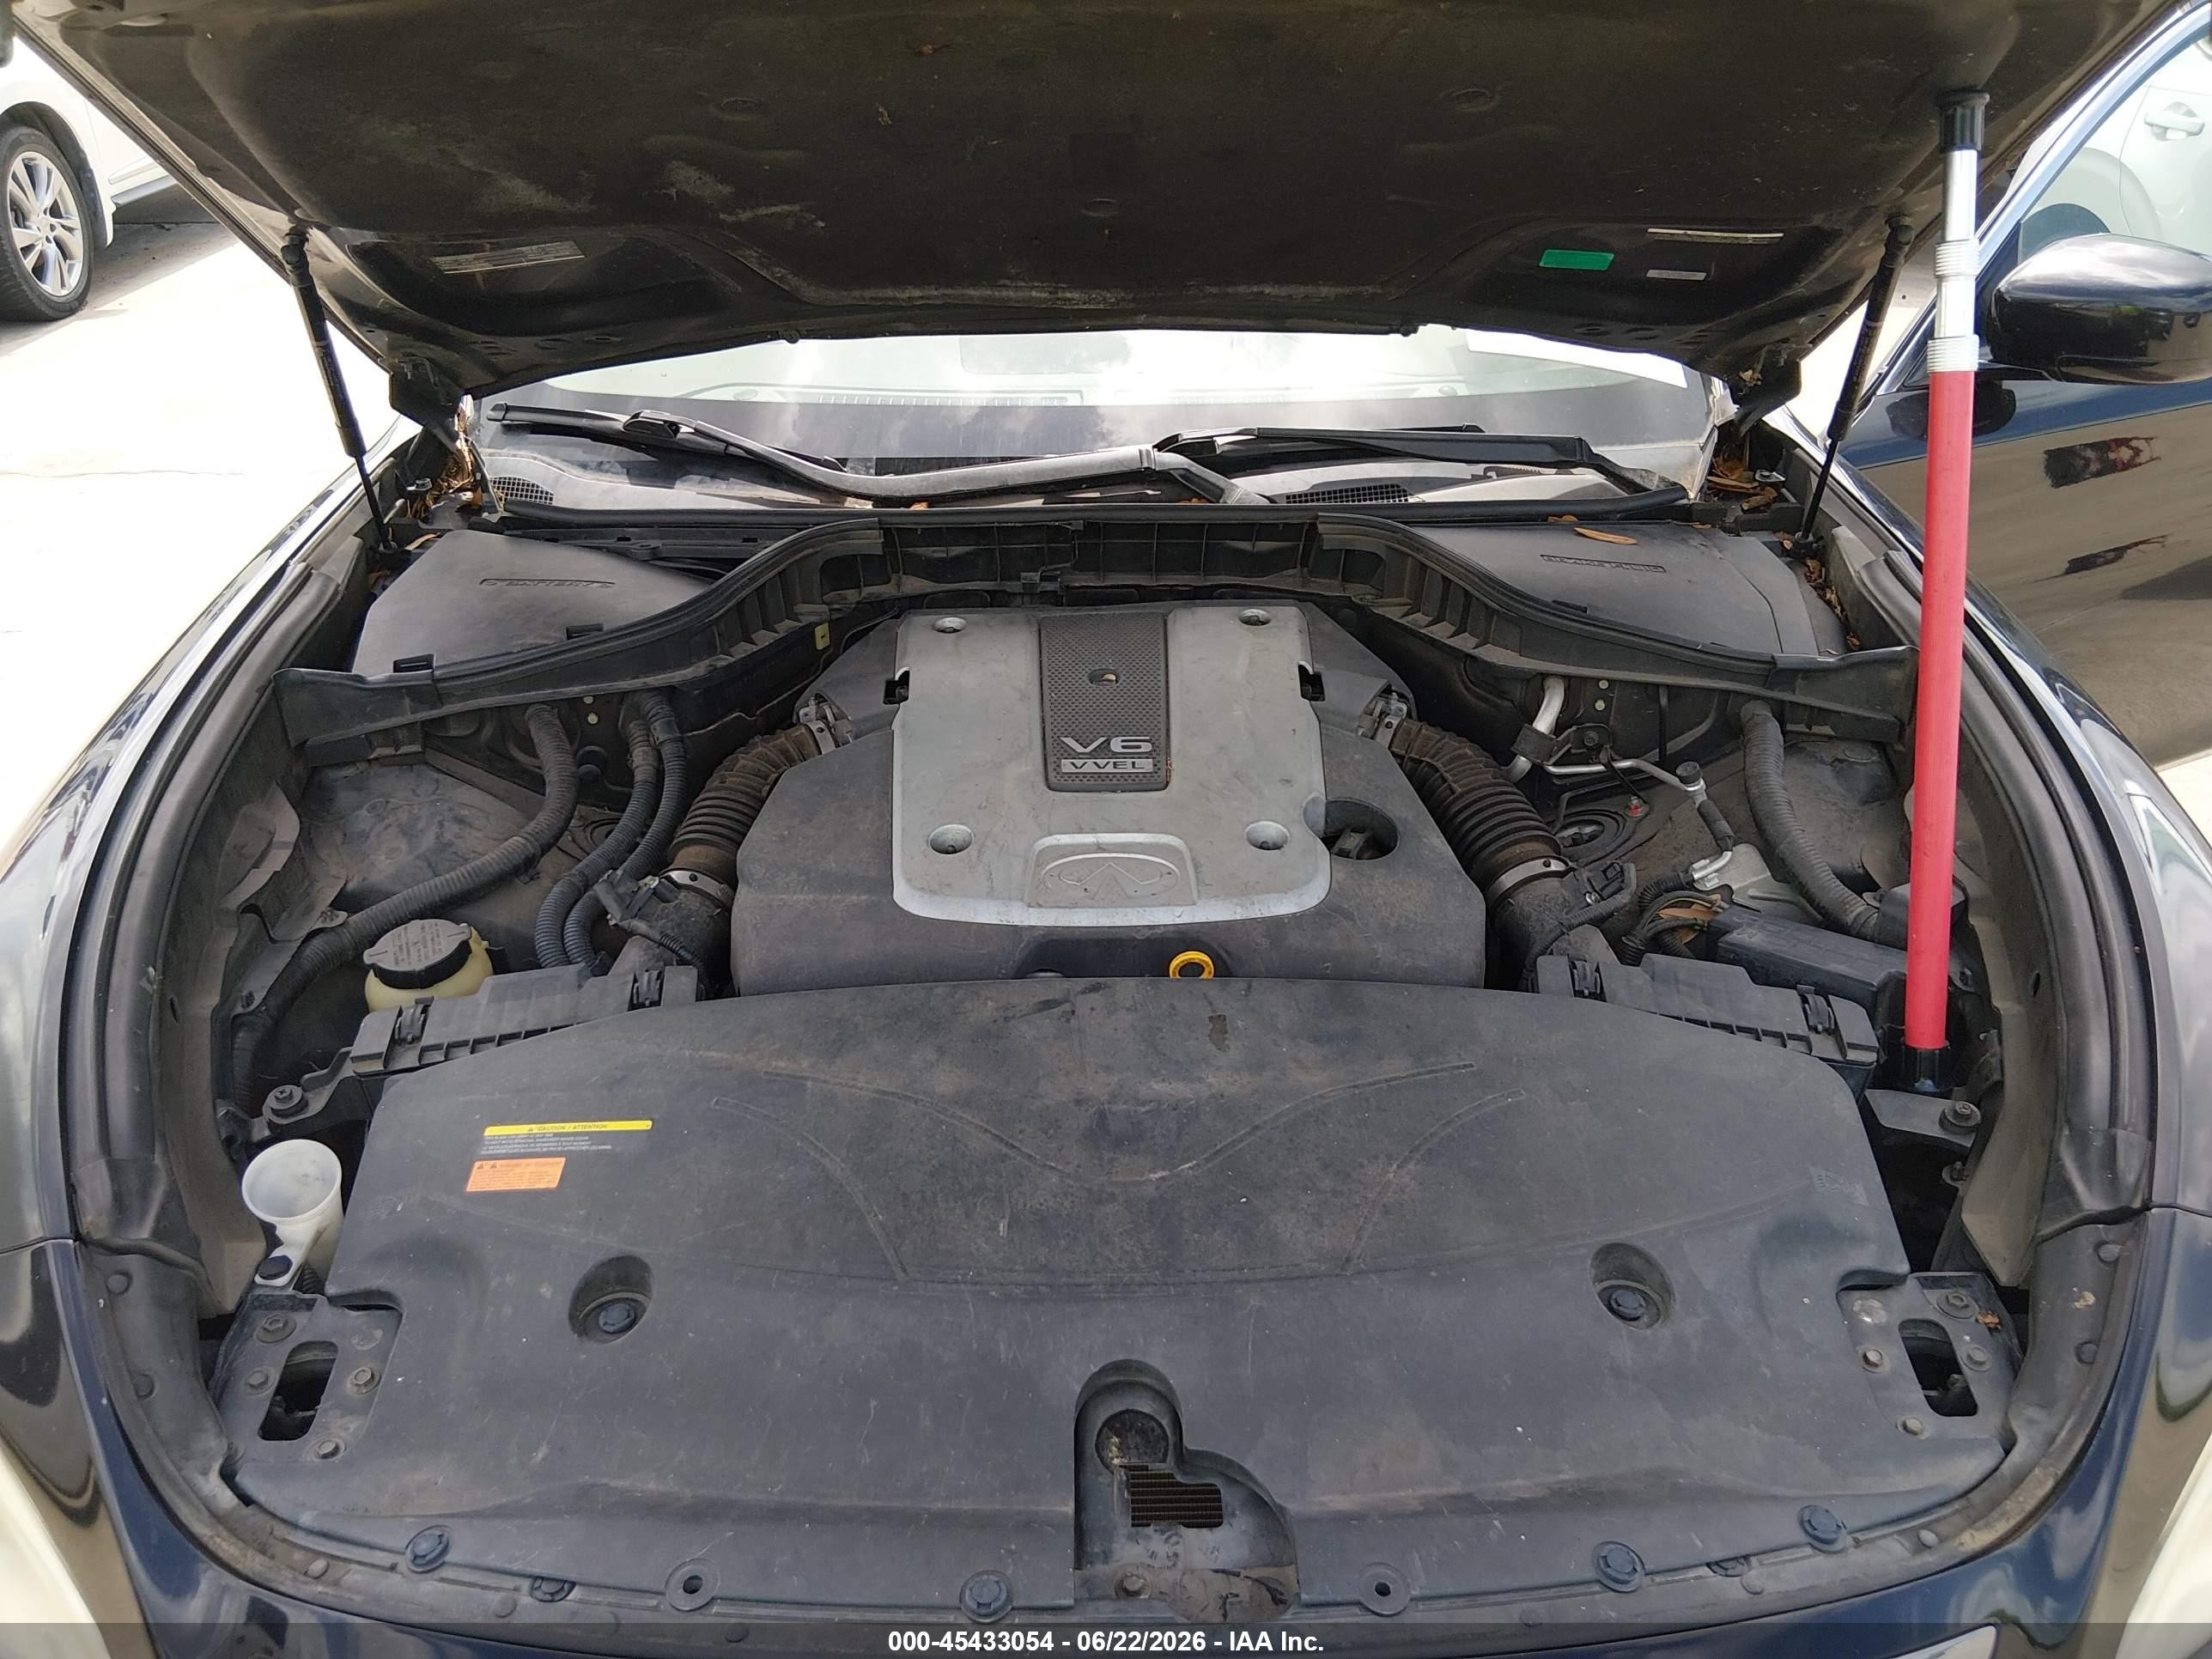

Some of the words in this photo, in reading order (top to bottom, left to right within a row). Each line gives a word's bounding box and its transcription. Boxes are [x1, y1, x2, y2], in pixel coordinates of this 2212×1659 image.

[1541, 556, 1606, 568] BRAKE
[1608, 562, 1664, 573] FLUID
[1060, 736, 1152, 753] V6
[1070, 761, 1146, 769] VVEL
